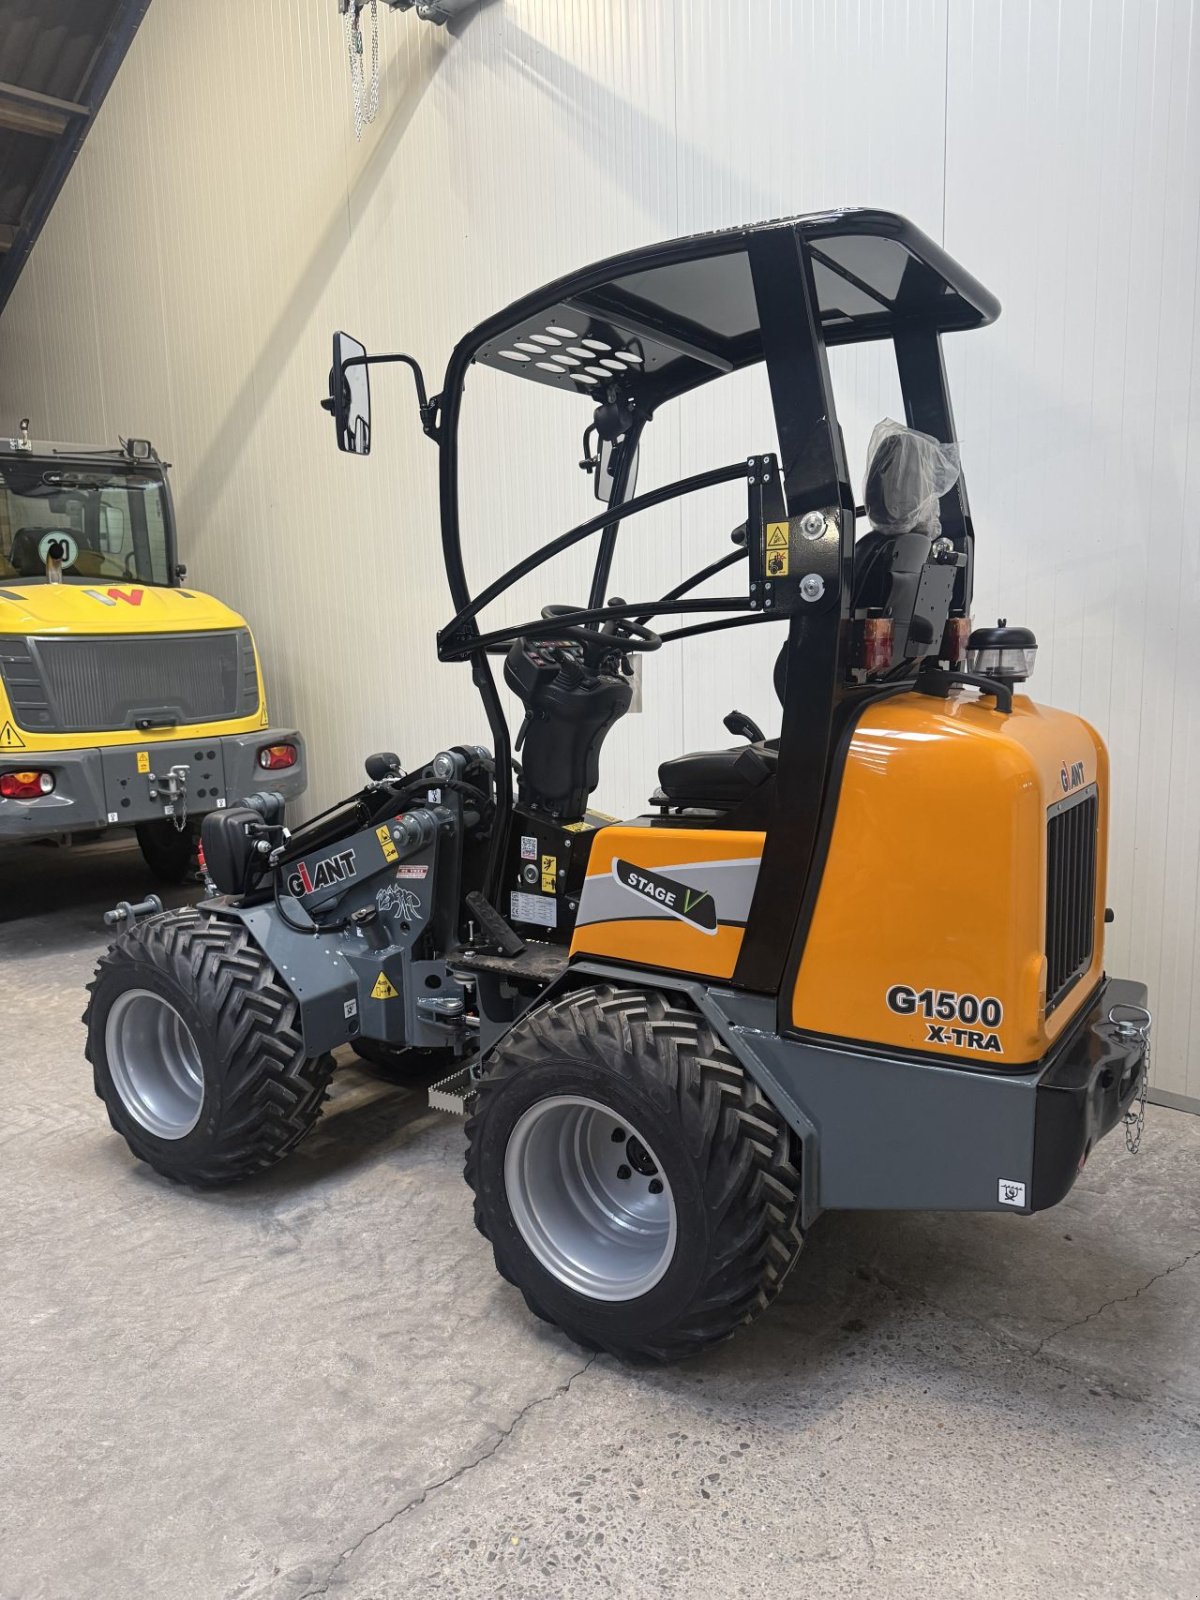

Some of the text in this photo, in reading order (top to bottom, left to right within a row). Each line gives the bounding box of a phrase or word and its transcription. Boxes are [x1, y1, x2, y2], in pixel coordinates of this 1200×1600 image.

[627, 873, 677, 906] STAGE
[886, 984, 1004, 1029] G1500
[925, 1023, 1005, 1054] X-TRA
